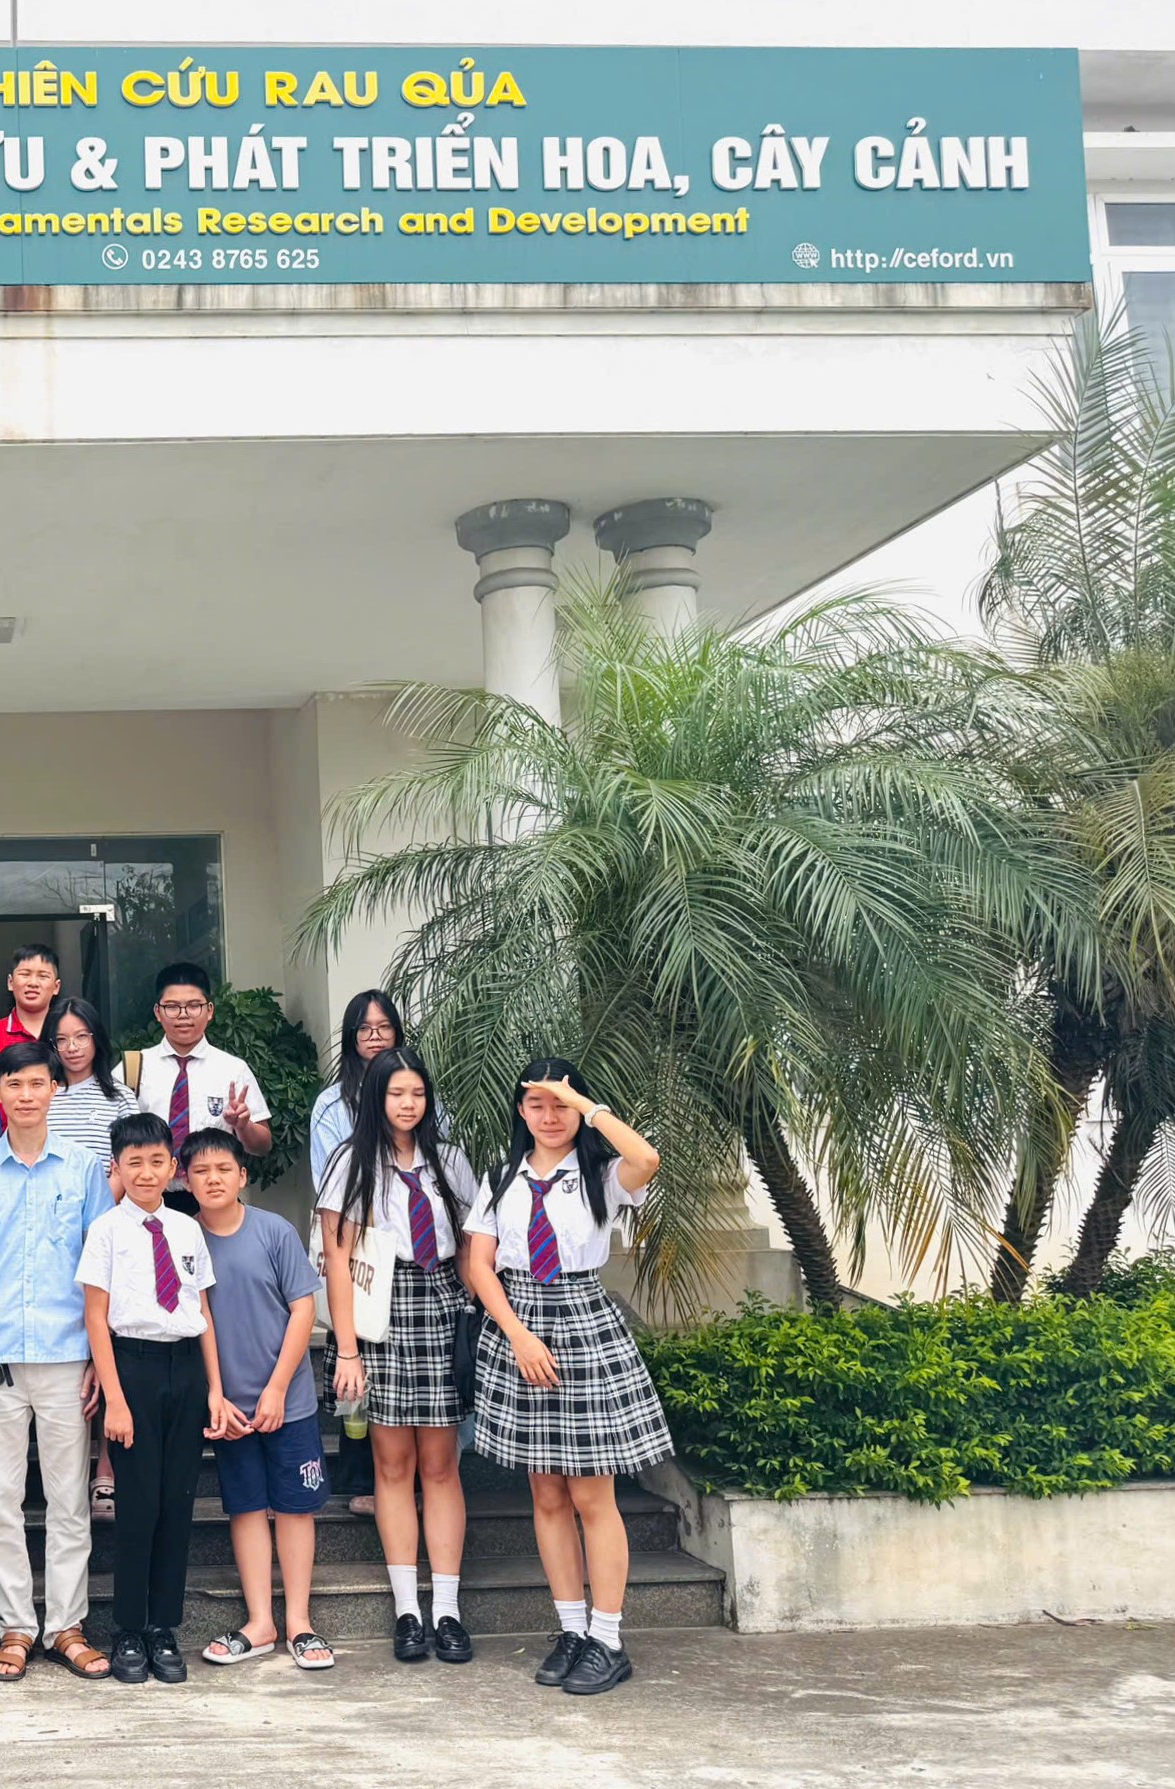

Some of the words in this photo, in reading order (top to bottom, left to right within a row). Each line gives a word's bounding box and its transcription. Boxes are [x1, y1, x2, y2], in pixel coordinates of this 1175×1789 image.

[121, 57, 240, 107] CỨU
[264, 70, 379, 107] RAU
[401, 57, 528, 107] QỦA
[70, 136, 119, 191] &
[144, 123, 308, 190] PHÁT
[333, 112, 519, 190] TRIỂN
[543, 136, 691, 197] HOA,
[712, 123, 830, 190] CÂY
[854, 117, 1030, 190] CẢNH
[197, 206, 384, 234] Research
[398, 207, 475, 234] and
[488, 207, 750, 239] Development
[142, 249, 203, 269] 0243
[212, 248, 268, 269] 8765
[276, 248, 320, 269] 625
[831, 247, 1014, 273] http://ceford.vn
